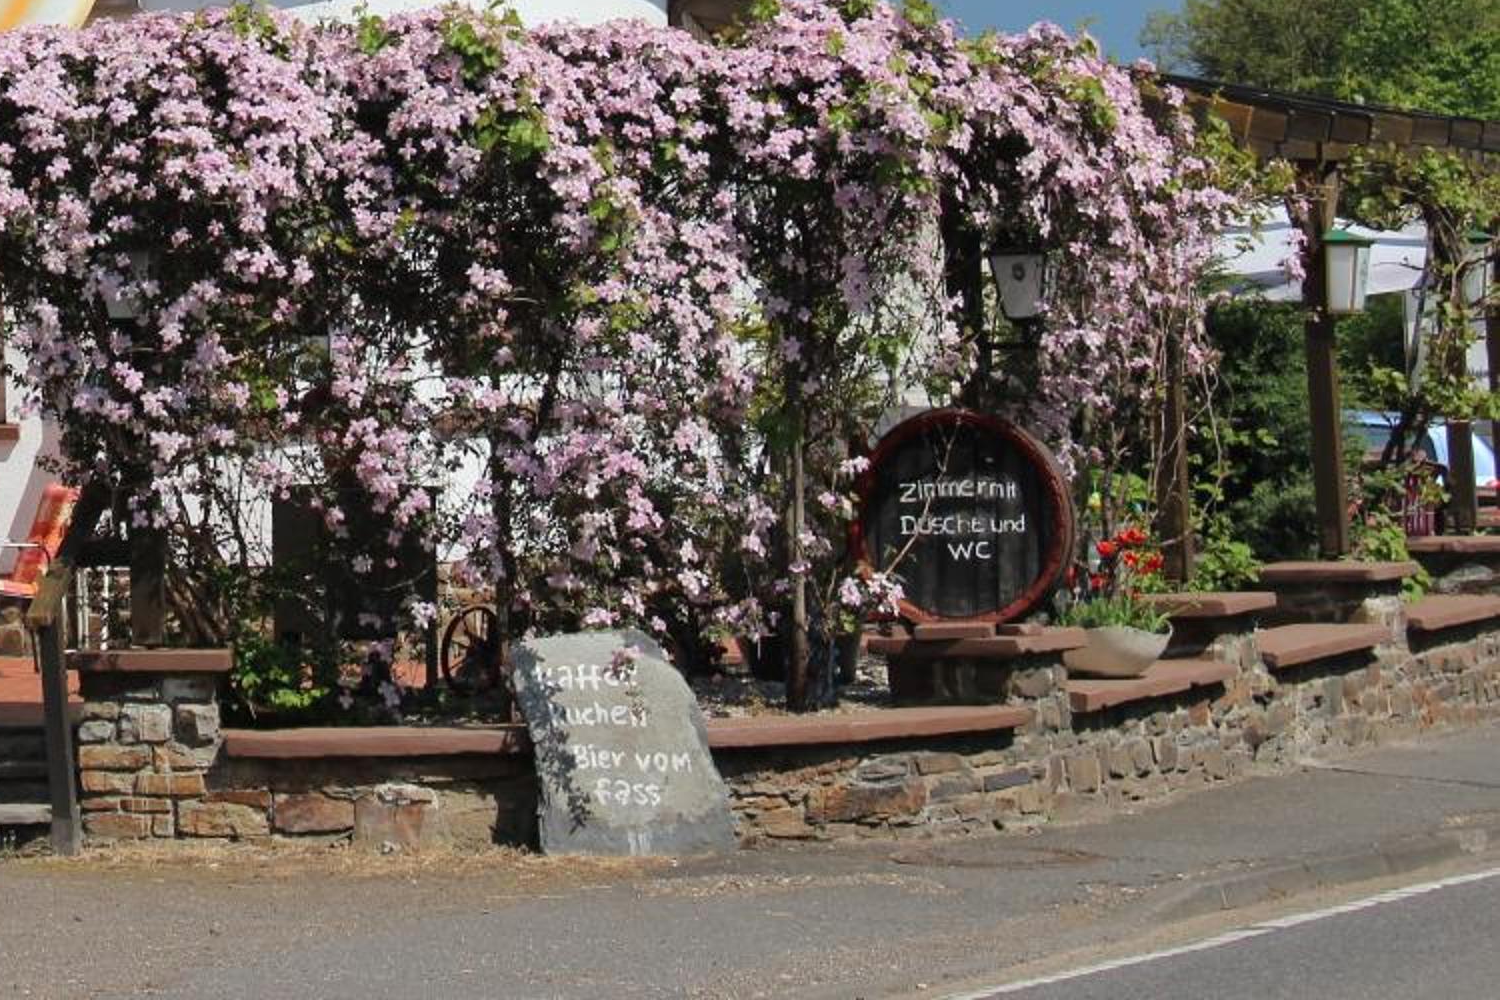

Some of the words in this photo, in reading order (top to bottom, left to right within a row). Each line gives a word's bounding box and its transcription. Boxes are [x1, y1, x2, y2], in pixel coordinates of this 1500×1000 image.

[899, 479, 987, 502] Zimmer
[990, 514, 1025, 533] und
[947, 541, 991, 560] WC
[572, 744, 625, 769] Bier
